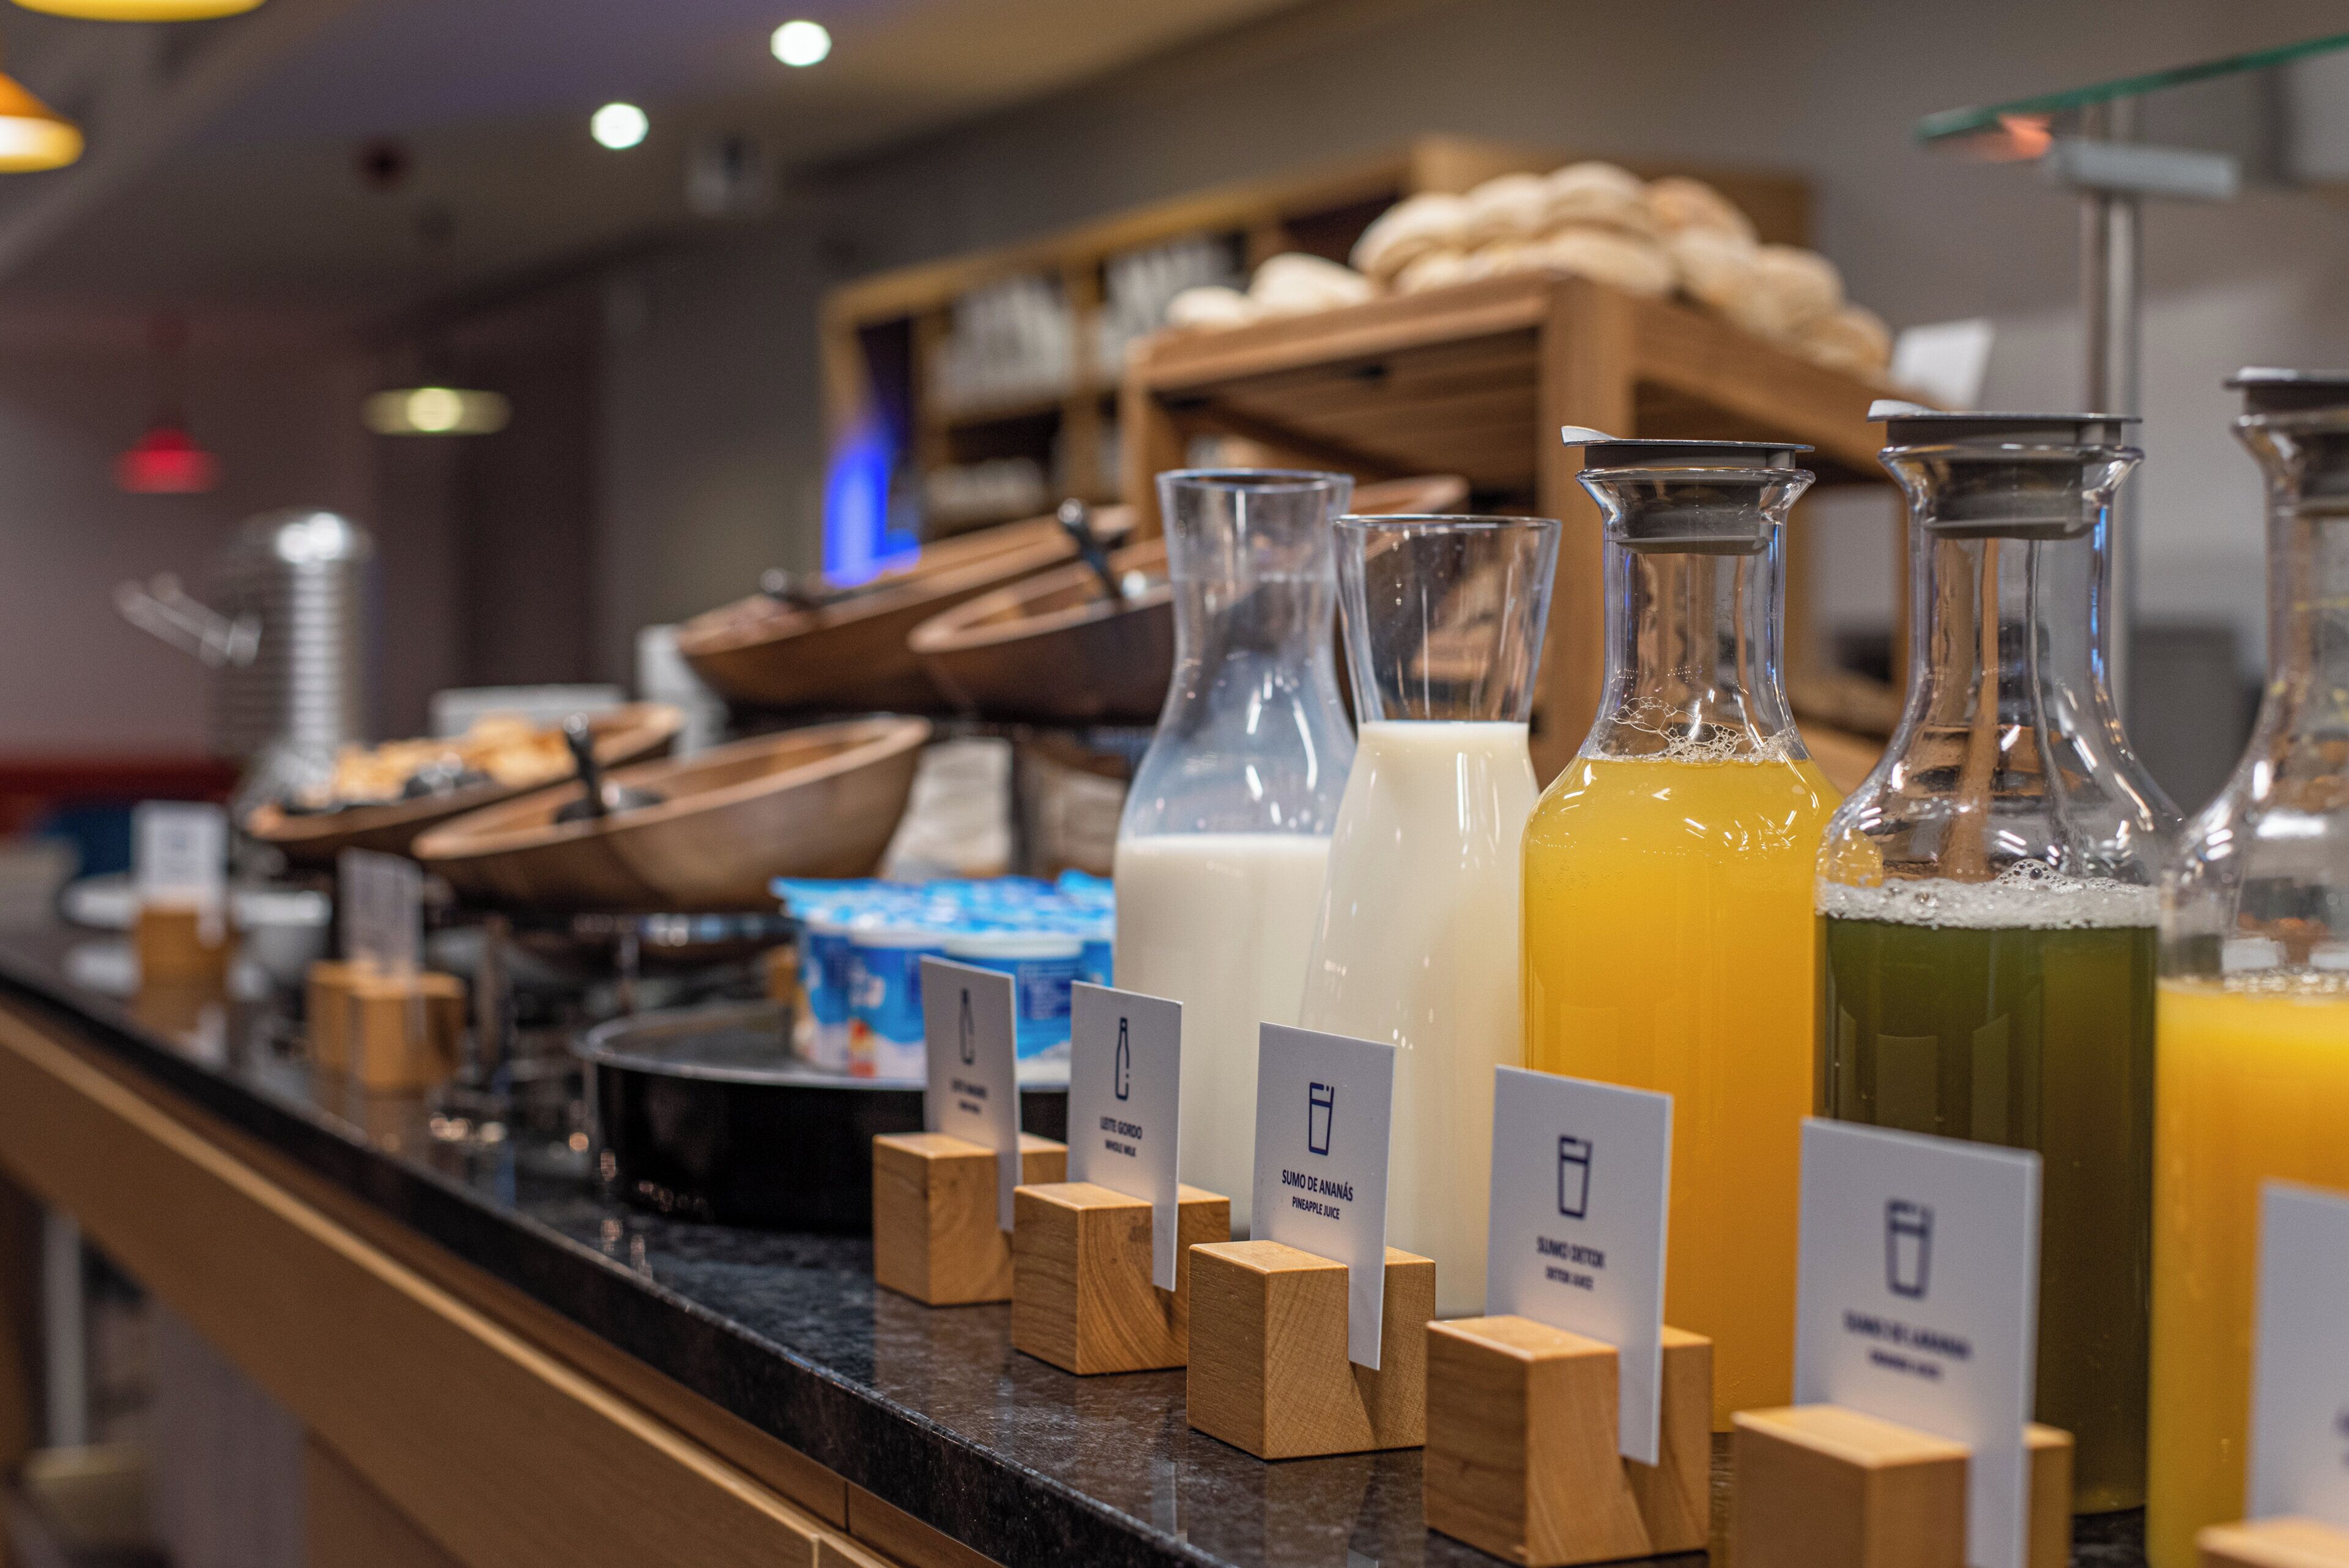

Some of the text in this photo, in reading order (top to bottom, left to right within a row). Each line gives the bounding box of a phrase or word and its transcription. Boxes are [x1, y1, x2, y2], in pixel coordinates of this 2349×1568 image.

[1118, 1121, 1142, 1139] GORDO
[1282, 1169, 1353, 1202] SUMO DE ANANÁS
[1292, 1196, 1340, 1220] PINEAPPLE JUICE
